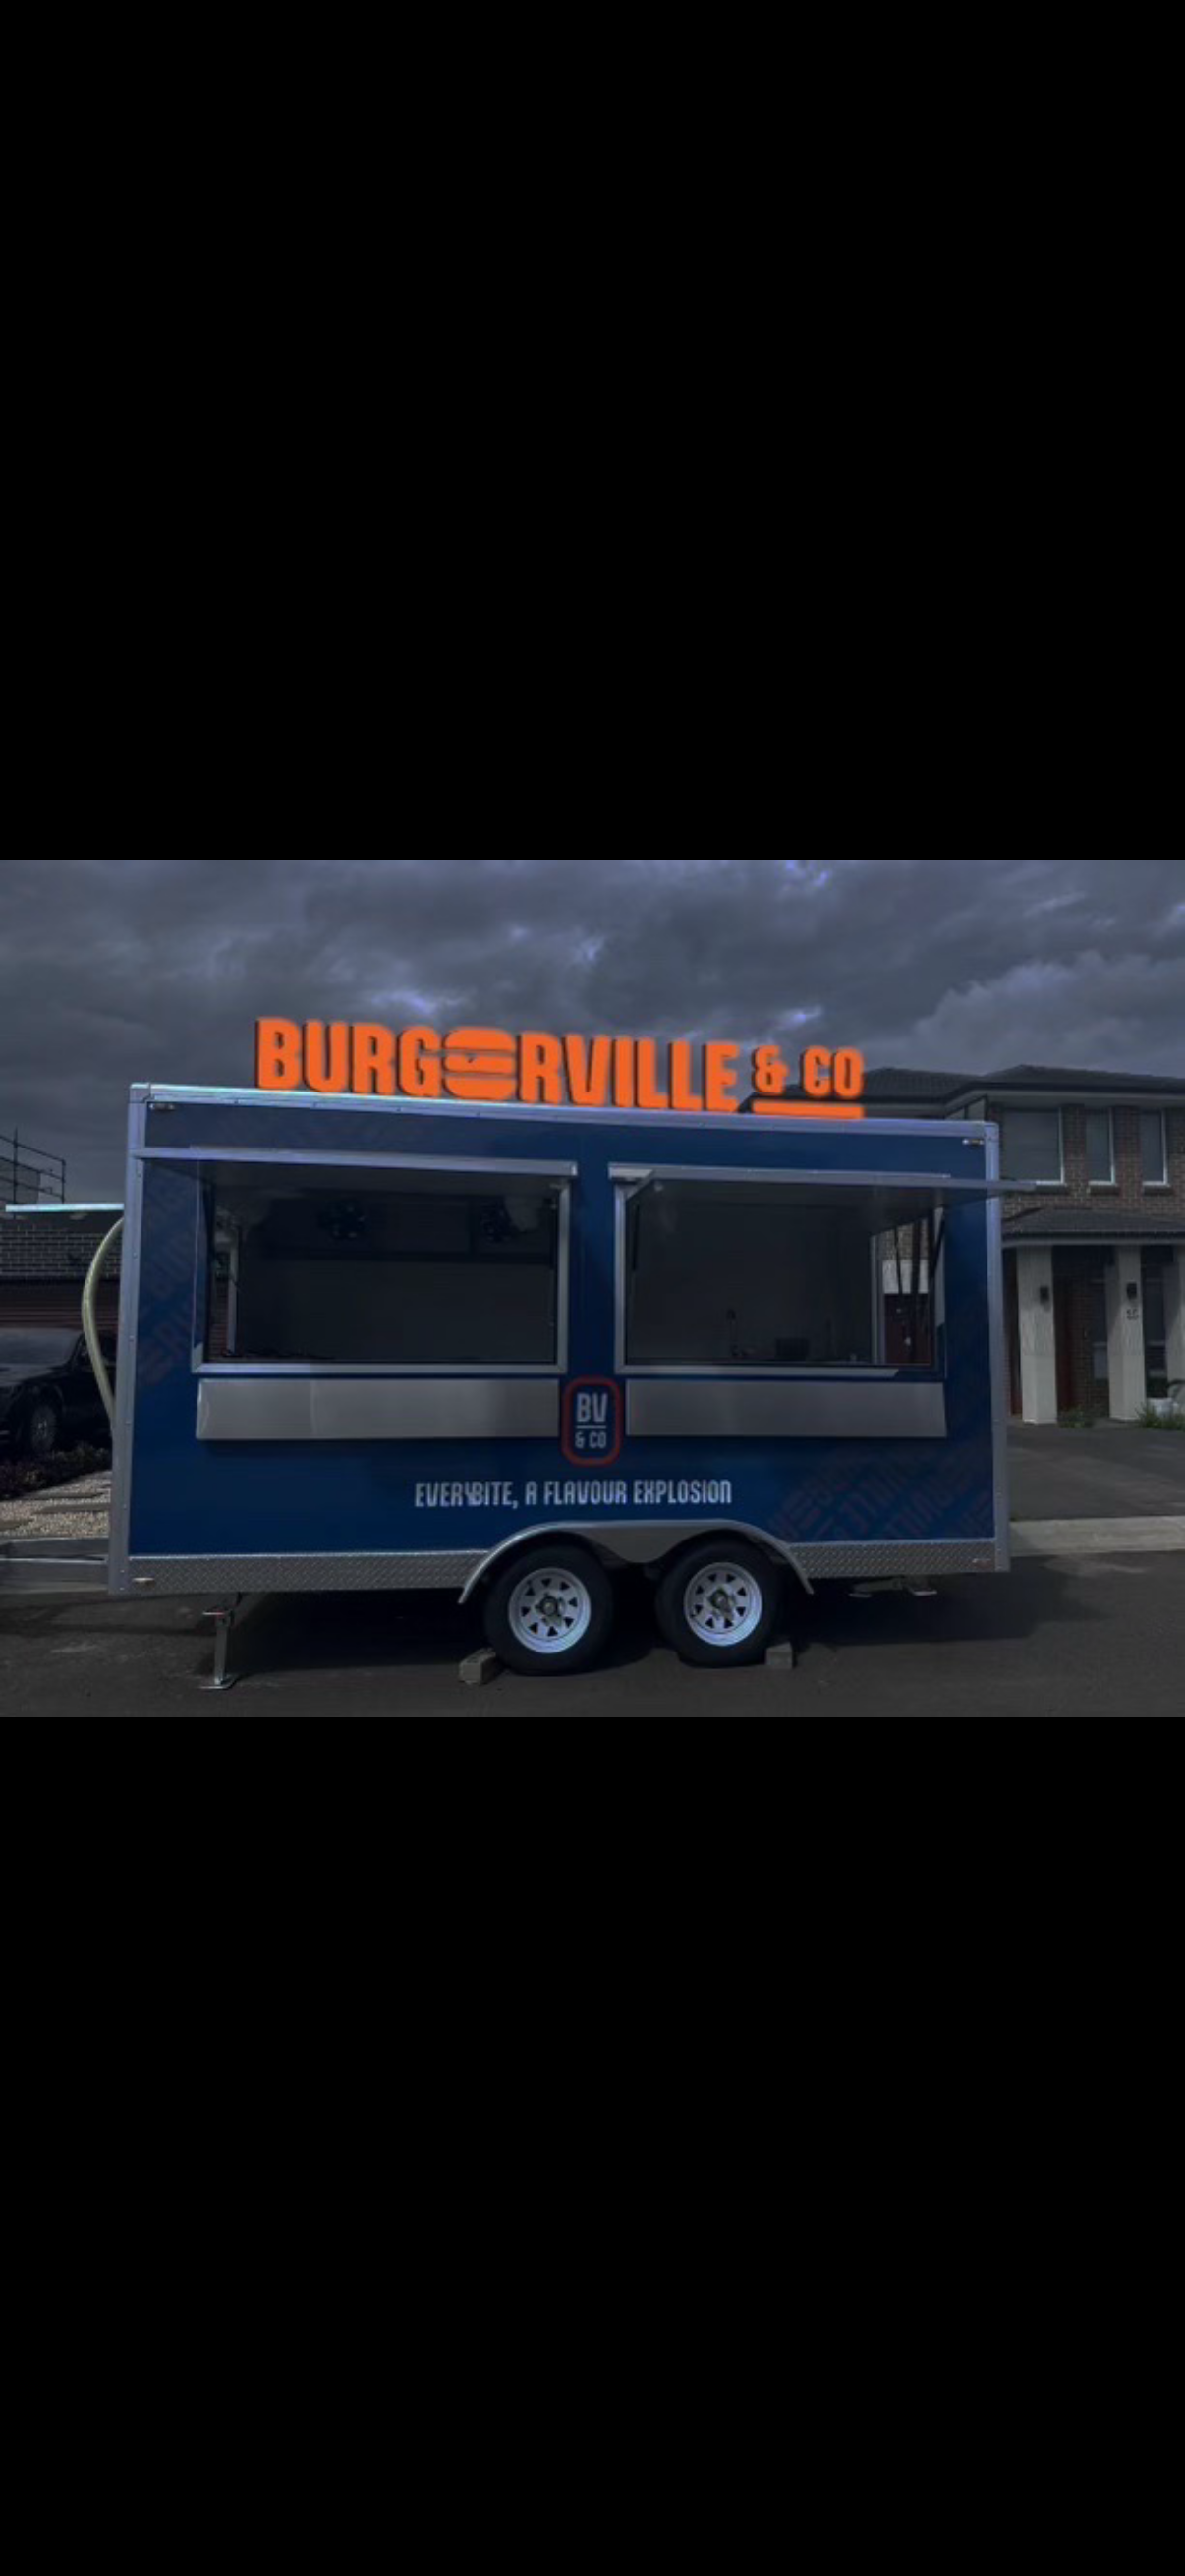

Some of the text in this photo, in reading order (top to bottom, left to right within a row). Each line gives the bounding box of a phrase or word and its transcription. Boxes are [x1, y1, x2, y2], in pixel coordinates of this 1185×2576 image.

[753, 1044, 789, 1096] &
[802, 1045, 865, 1100] CO
[576, 1393, 608, 1423] BV
[574, 1430, 607, 1449] & CO
[524, 1481, 538, 1506] A
[542, 1480, 628, 1506] FLAVOUR
[632, 1478, 732, 1505] EXPLOSION
